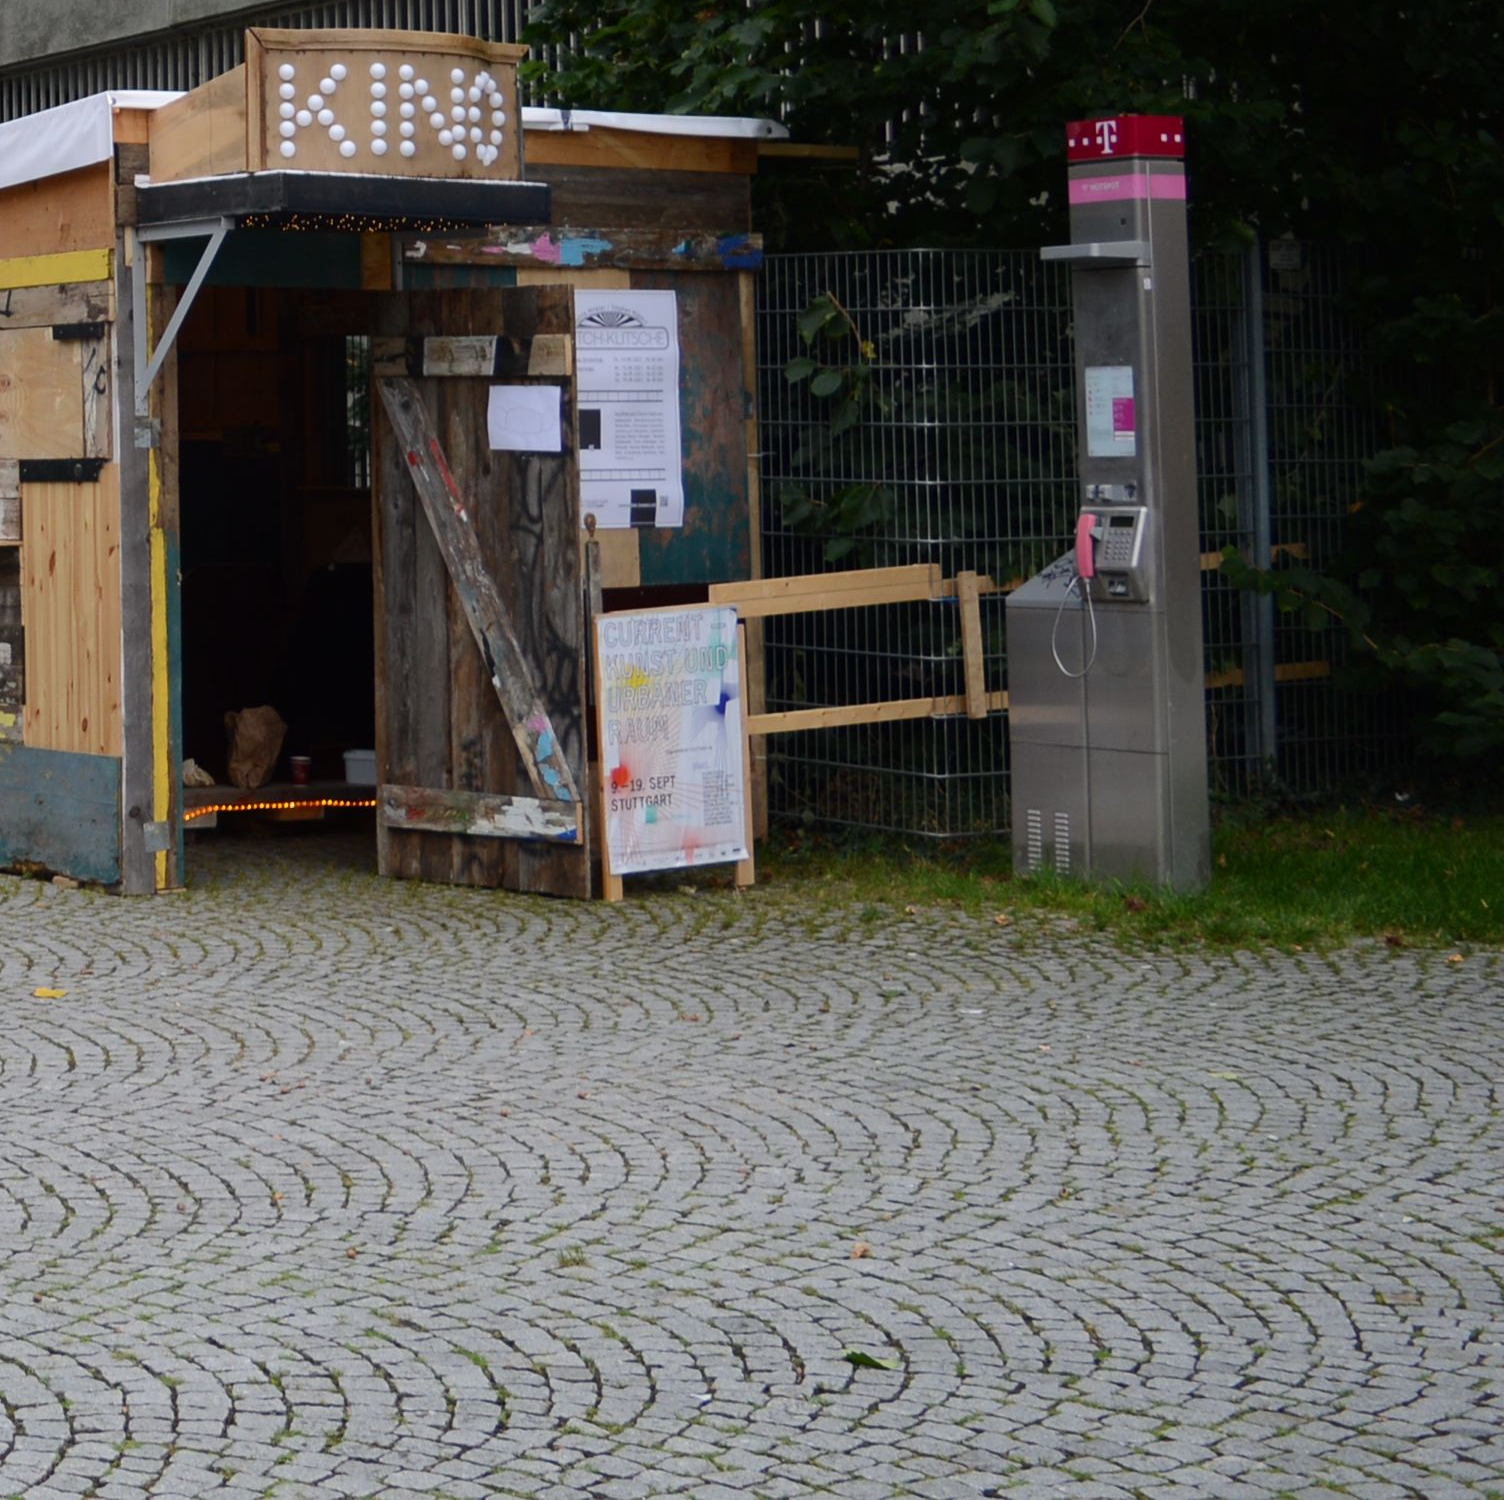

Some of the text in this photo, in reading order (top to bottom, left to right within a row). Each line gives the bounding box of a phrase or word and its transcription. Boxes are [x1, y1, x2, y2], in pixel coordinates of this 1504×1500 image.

[278, 63, 506, 167] KINO
[1095, 120, 1117, 154] T
[604, 613, 703, 648] CURRENT
[606, 644, 728, 680] KUNST UND
[607, 678, 708, 713] URBANER
[649, 775, 676, 790] SEPT
[611, 793, 673, 812] STUTTGART
